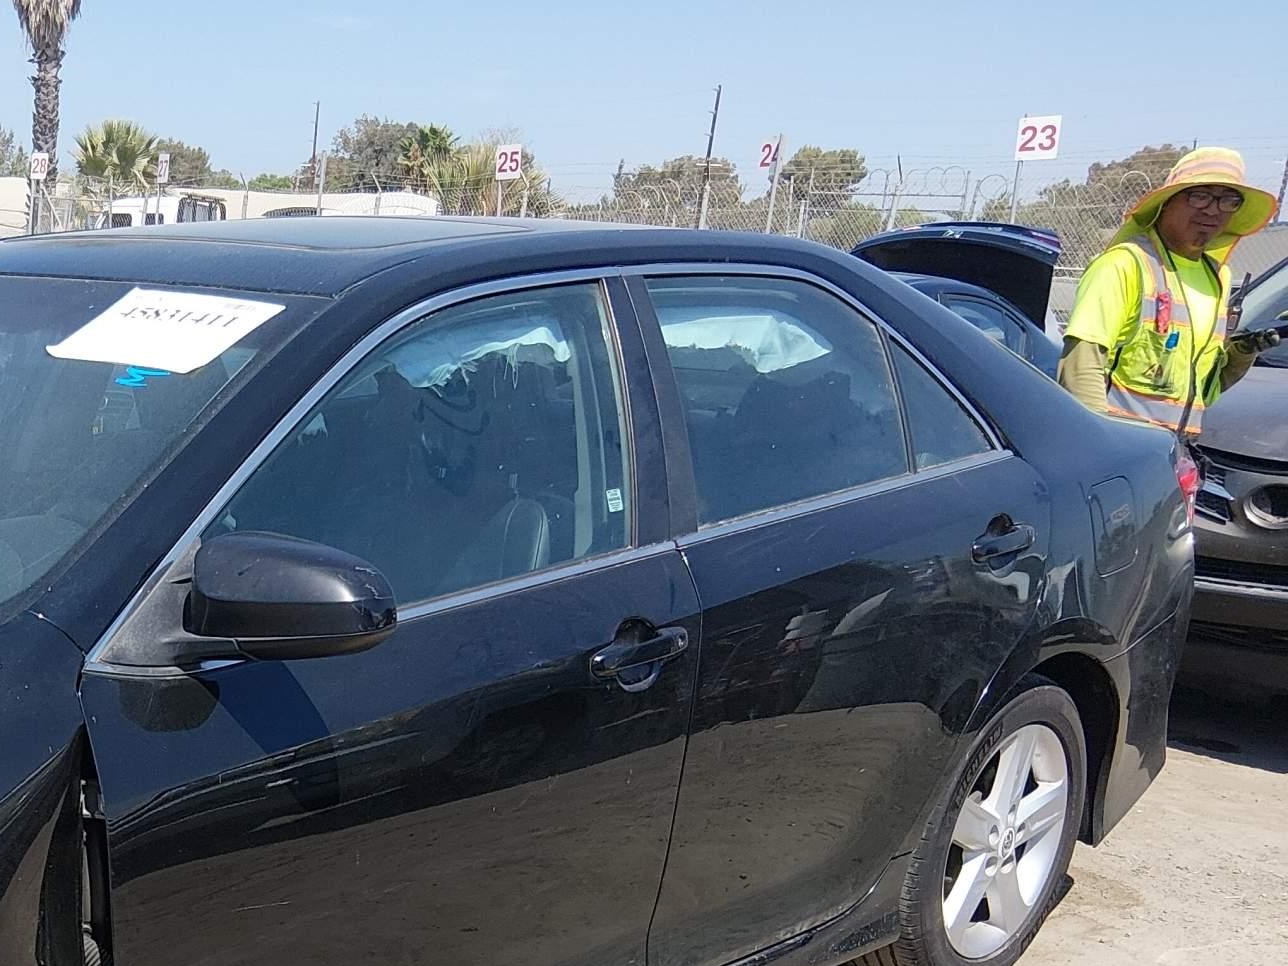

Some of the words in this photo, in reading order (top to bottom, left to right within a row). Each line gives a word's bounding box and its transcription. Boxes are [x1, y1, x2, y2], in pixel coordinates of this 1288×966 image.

[1018, 125, 1057, 152] 23
[32, 158, 46, 173] 28
[159, 160, 168, 177] 27
[497, 151, 519, 173] 25
